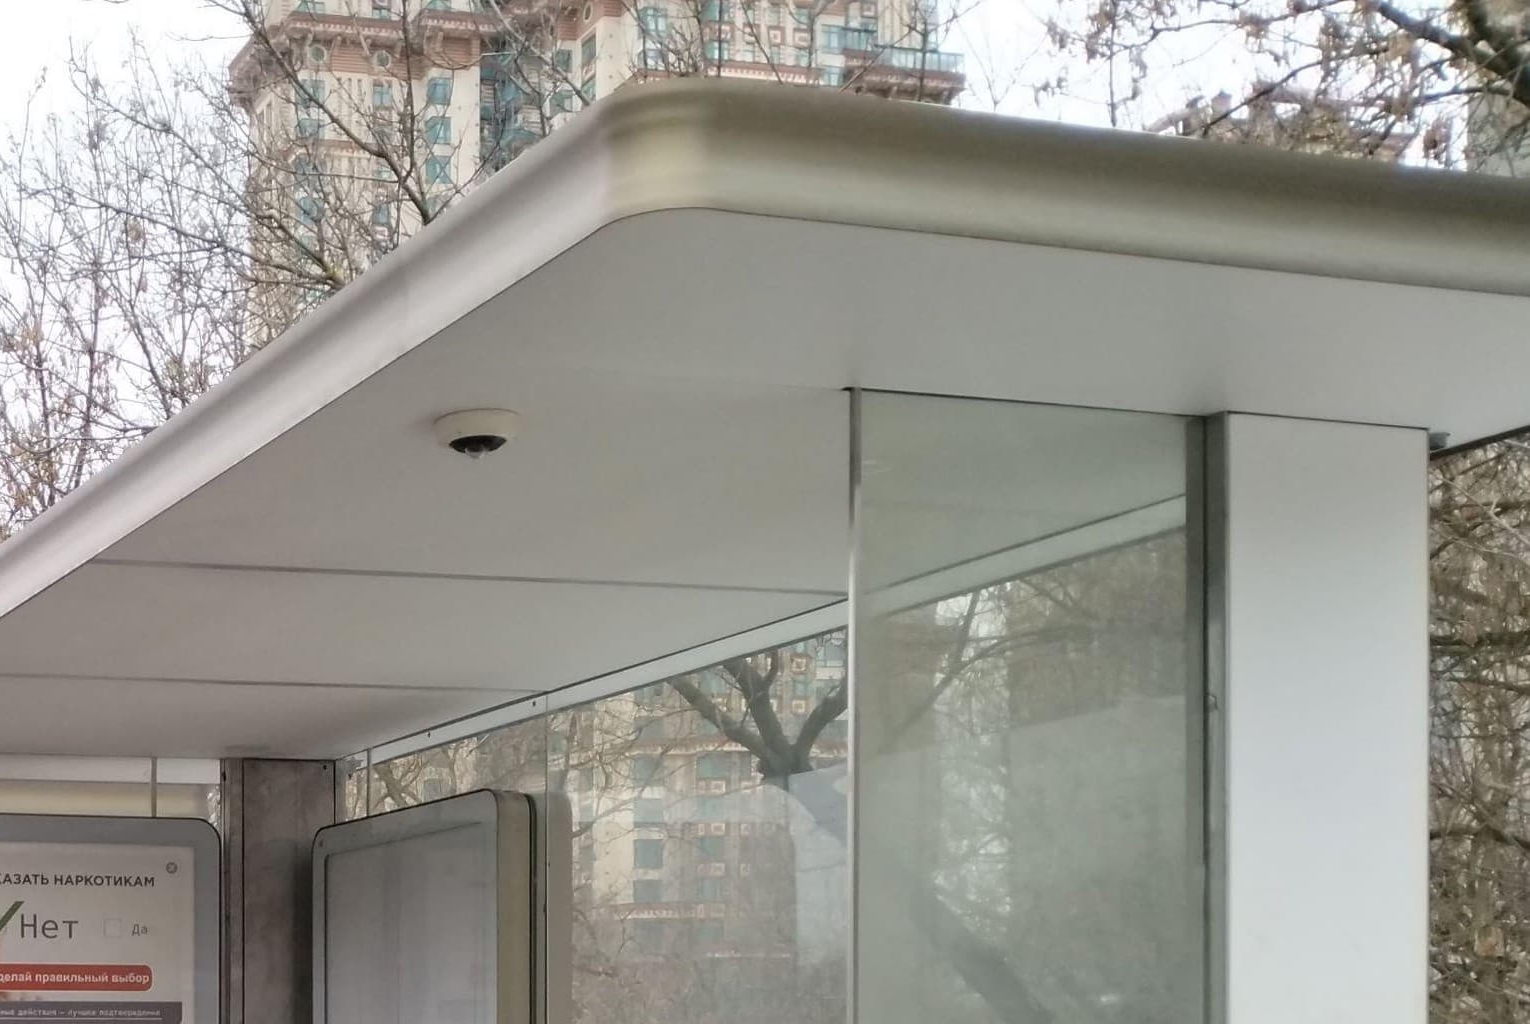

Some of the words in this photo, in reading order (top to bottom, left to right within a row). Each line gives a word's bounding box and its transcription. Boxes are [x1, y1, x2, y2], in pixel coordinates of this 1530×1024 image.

[54, 874, 155, 887] НАРКОТИКАМ
[20, 913, 79, 939] Нет
[131, 924, 148, 937] Да
[35, 971, 108, 984] правильный
[111, 973, 150, 985] выбор
